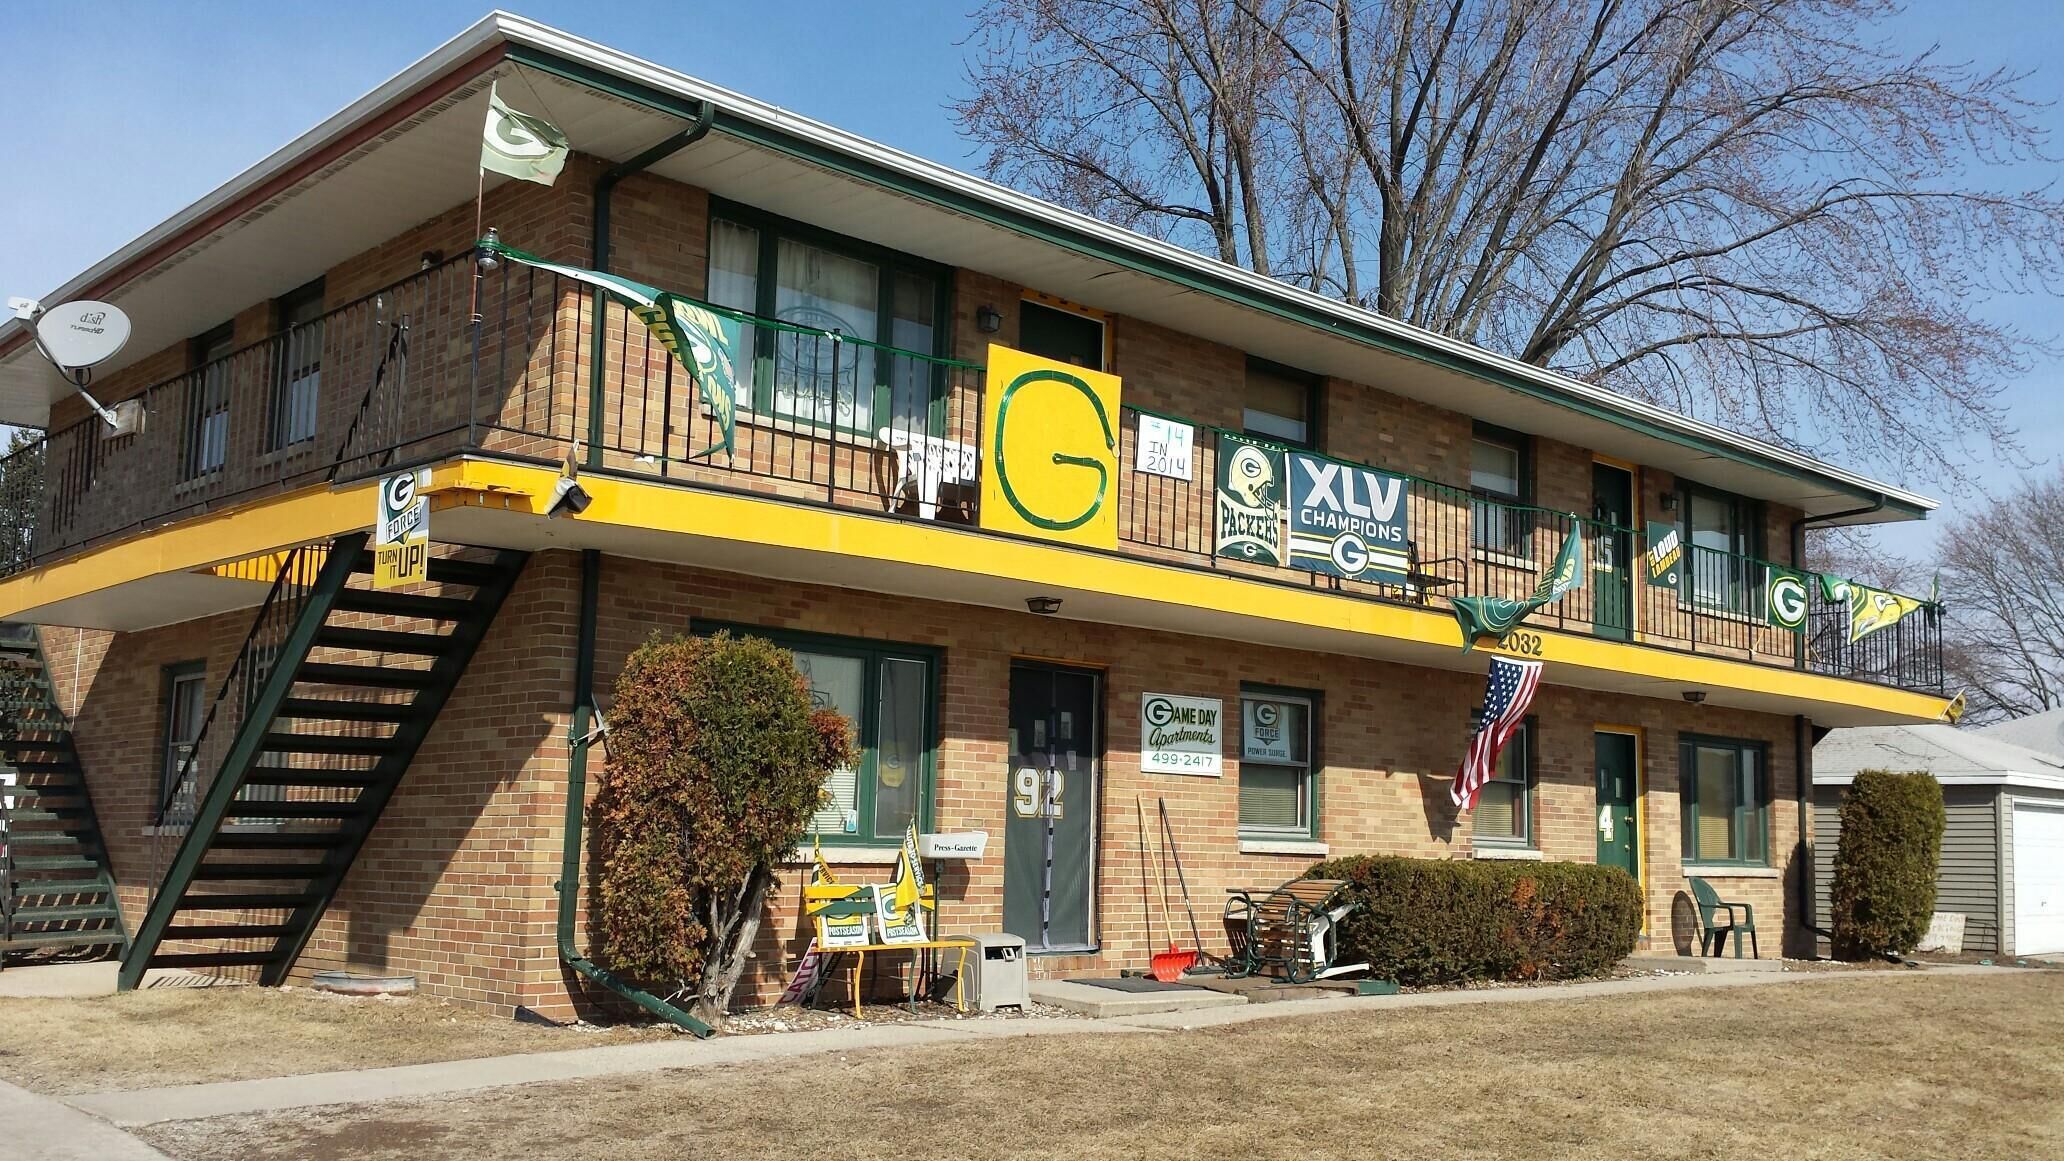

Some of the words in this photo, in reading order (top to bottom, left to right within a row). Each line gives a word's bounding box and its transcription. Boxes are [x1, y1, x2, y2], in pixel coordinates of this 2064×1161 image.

[1148, 440, 1168, 457] IN
[1147, 455, 1185, 476] 2014
[1298, 457, 1402, 522] XLV
[387, 506, 420, 540] FORCE
[1301, 508, 1402, 542] CHAMPIONS
[378, 548, 398, 566] TURN
[398, 543, 425, 578] UP!
[1332, 532, 1369, 575] G
[1652, 529, 1679, 563] LOUD
[389, 564, 397, 580] IT
[1651, 545, 1681, 579] LAMBEAU
[1771, 577, 1808, 627] G
[1145, 698, 1197, 727] GAME
[1197, 709, 1218, 727] DAY
[1149, 726, 1216, 751] Apartments
[1255, 727, 1280, 739] FORCE
[1247, 746, 1267, 756] POWER
[1014, 767, 1065, 819] 92
[1599, 802, 1614, 841] 4
[934, 843, 978, 852] Press-Gazette
[828, 925, 863, 937] POSTSEASON
[886, 926, 920, 939] POSTSEASON
